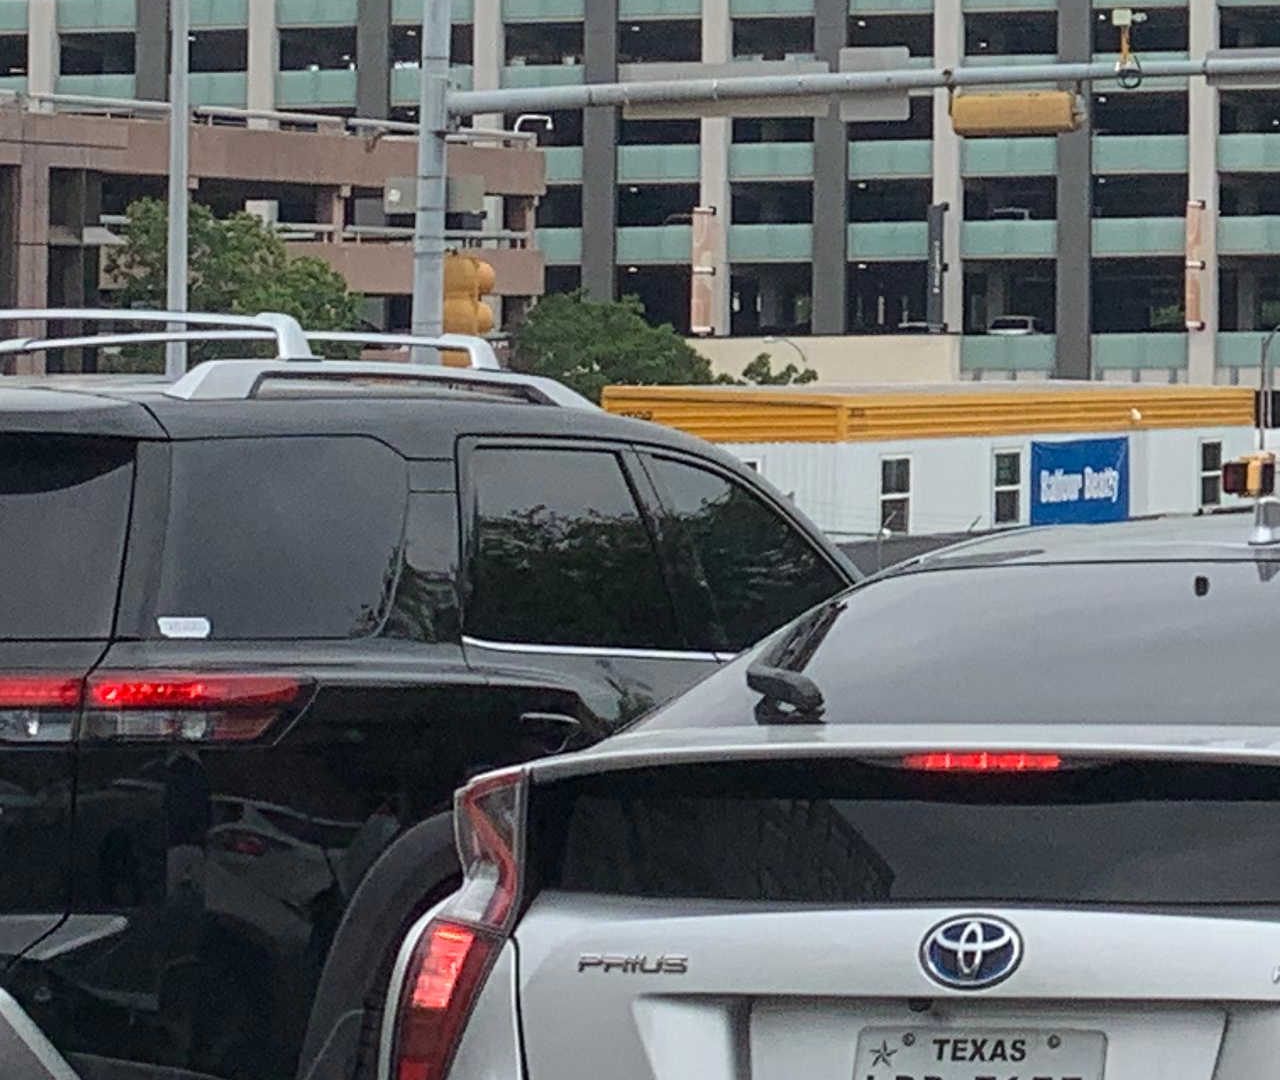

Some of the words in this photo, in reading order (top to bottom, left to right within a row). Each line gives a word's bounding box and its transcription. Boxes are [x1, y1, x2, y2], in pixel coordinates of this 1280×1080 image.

[1041, 468, 1082, 503] Balfour
[1084, 466, 1119, 503] Beatty
[578, 953, 688, 973] PRIUS
[933, 1038, 1027, 1062] TEXAS
